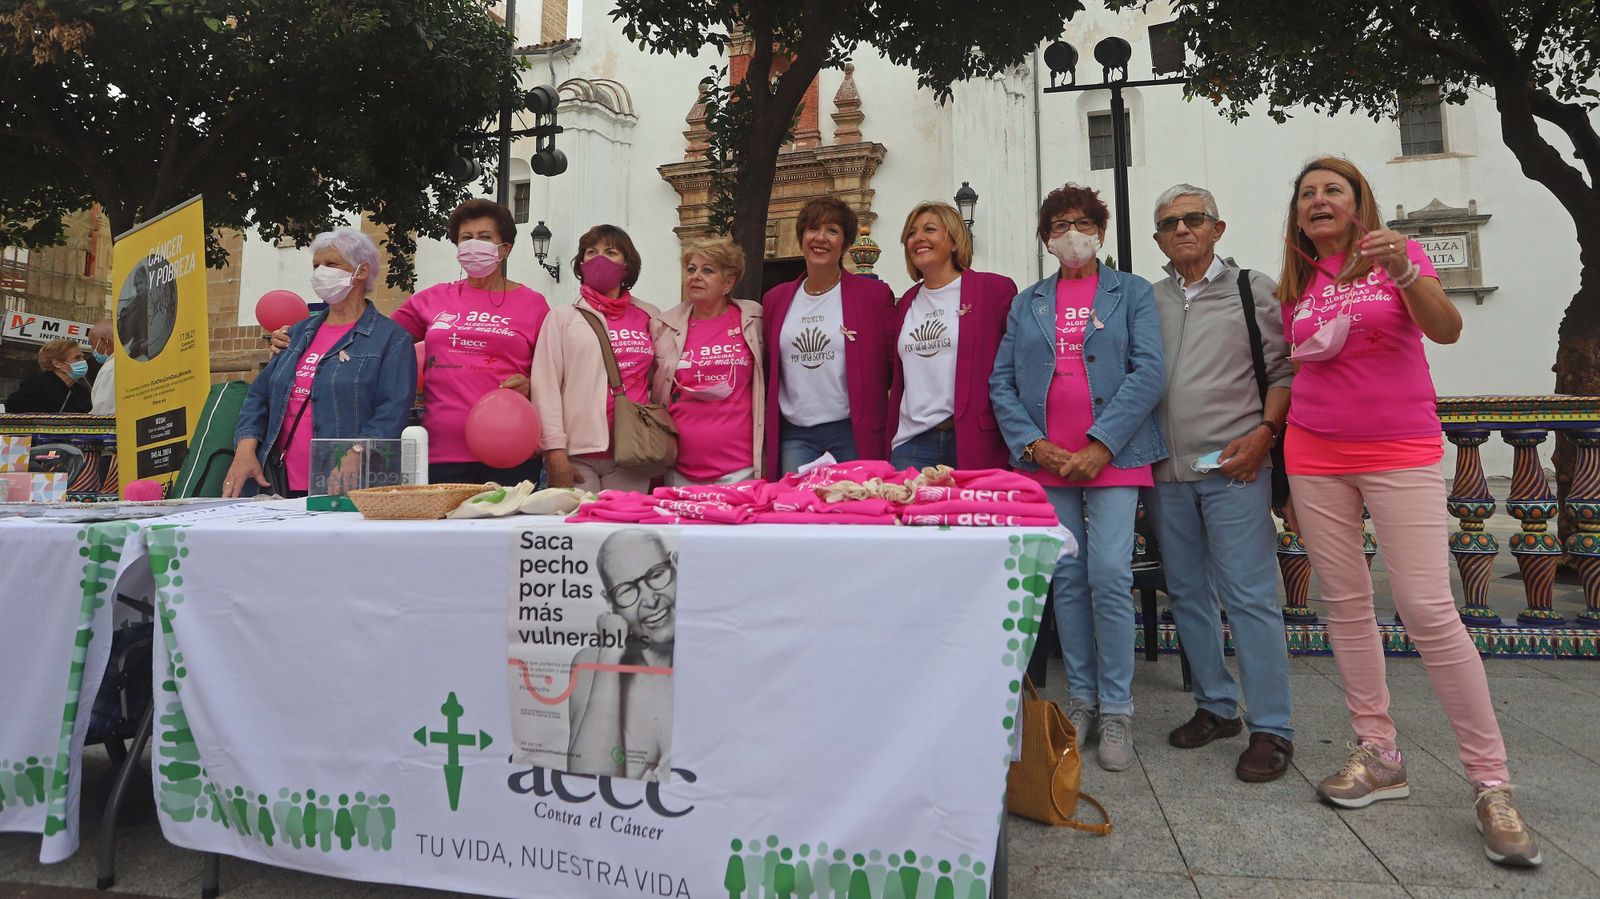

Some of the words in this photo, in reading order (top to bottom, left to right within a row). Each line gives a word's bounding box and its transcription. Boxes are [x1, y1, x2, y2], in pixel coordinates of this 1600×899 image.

[148, 234, 183, 267] CÁNCER
[149, 270, 155, 290] Y
[156, 251, 196, 287] POBREZA
[466, 310, 511, 325] aecc
[1064, 307, 1090, 320] ae
[460, 339, 487, 348] aecc
[610, 329, 649, 341] aecc
[700, 343, 742, 356] aecc
[520, 531, 573, 550] Saca
[519, 555, 589, 578] pecho
[519, 581, 556, 602] por
[562, 579, 593, 599] las
[519, 602, 563, 622] más
[534, 801, 581, 827] Contra
[589, 811, 602, 830] el
[610, 815, 664, 841] Cáncer
[416, 833, 444, 858] TU
[452, 838, 513, 868] VIDA,
[521, 845, 629, 889] NUESTRA
[634, 868, 692, 899] VIDA
